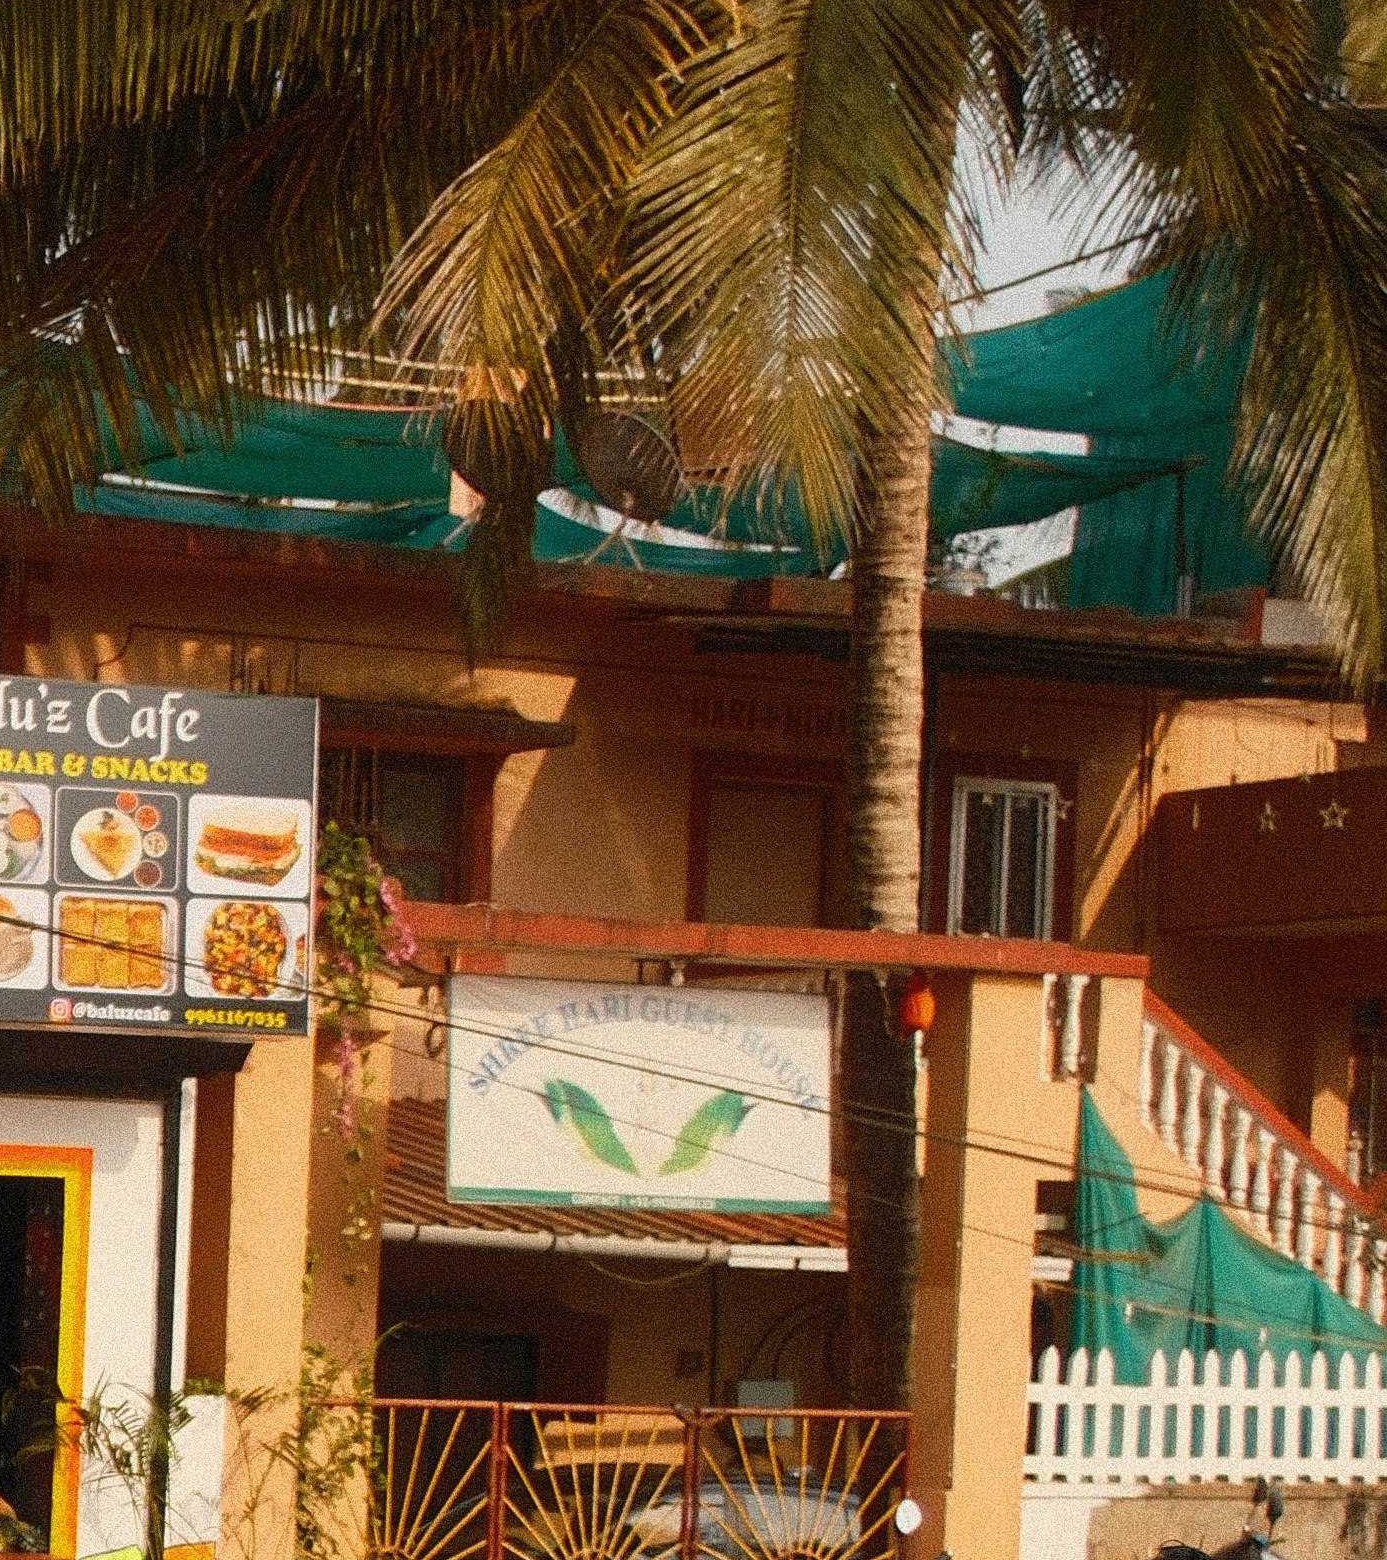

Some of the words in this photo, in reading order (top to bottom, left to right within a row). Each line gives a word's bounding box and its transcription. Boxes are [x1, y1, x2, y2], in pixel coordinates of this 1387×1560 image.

[86, 689, 200, 762] Cafe
[62, 753, 85, 778] &
[91, 756, 208, 785] SNACKS
